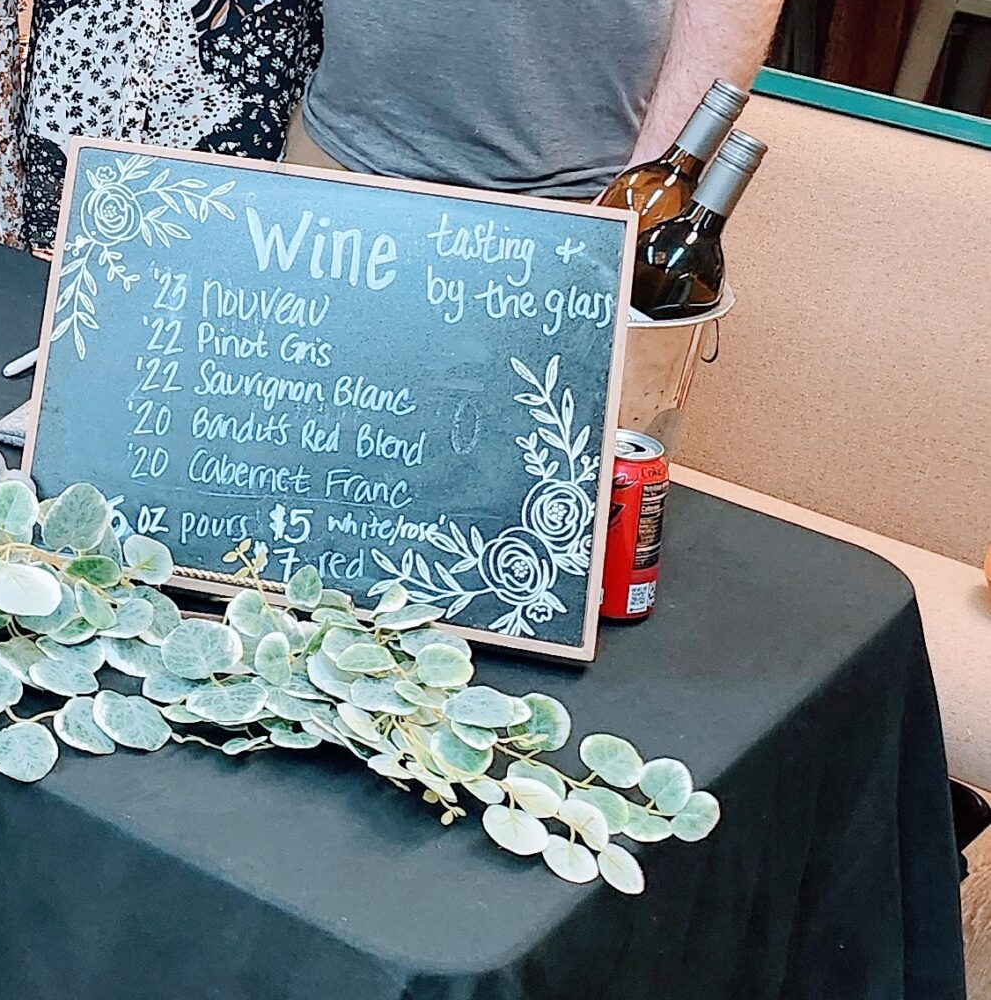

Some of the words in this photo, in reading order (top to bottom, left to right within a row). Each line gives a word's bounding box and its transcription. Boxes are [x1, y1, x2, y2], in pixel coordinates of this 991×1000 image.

[246, 206, 398, 291] Wine
[427, 212, 536, 287] tasting
[427, 265, 464, 324] by
[473, 280, 538, 319] the
[542, 285, 614, 336] glass
[197, 321, 269, 359] Pinot
[279, 333, 333, 368] Gris
[194, 359, 326, 411] Sauvignon
[332, 375, 417, 416] Blanc
[301, 421, 340, 453] Red
[356, 423, 426, 467] Blend
[188, 448, 311, 493] Cabernet
[325, 468, 413, 509] Franc
[181, 511, 250, 545] pours
[269, 503, 314, 544] $5
[318, 548, 364, 580] red
